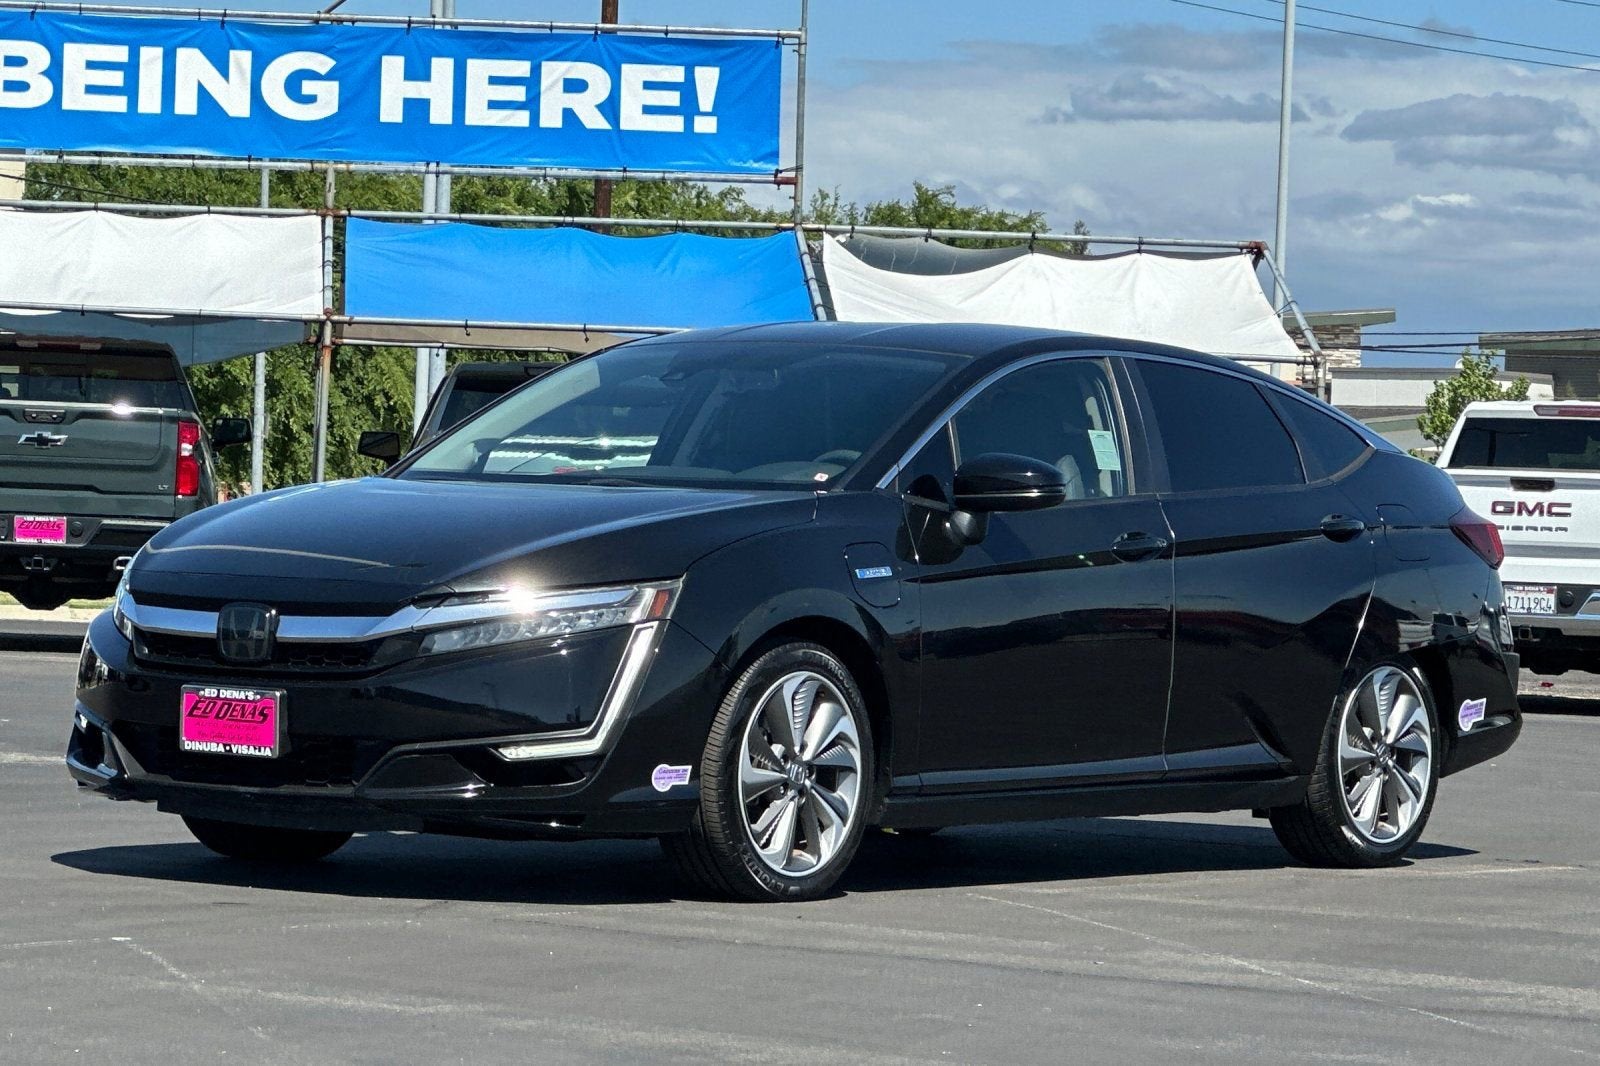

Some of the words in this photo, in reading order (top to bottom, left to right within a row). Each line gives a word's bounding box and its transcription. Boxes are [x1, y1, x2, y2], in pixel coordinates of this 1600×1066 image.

[0, 39, 340, 121] BEING
[379, 55, 721, 134] HERE!
[1491, 501, 1572, 517] GMC
[204, 688, 218, 697] ED
[219, 690, 255, 700] DENA'S
[186, 700, 219, 718] ED
[184, 740, 225, 752] DINUBA
[232, 744, 272, 757] VISALIA
